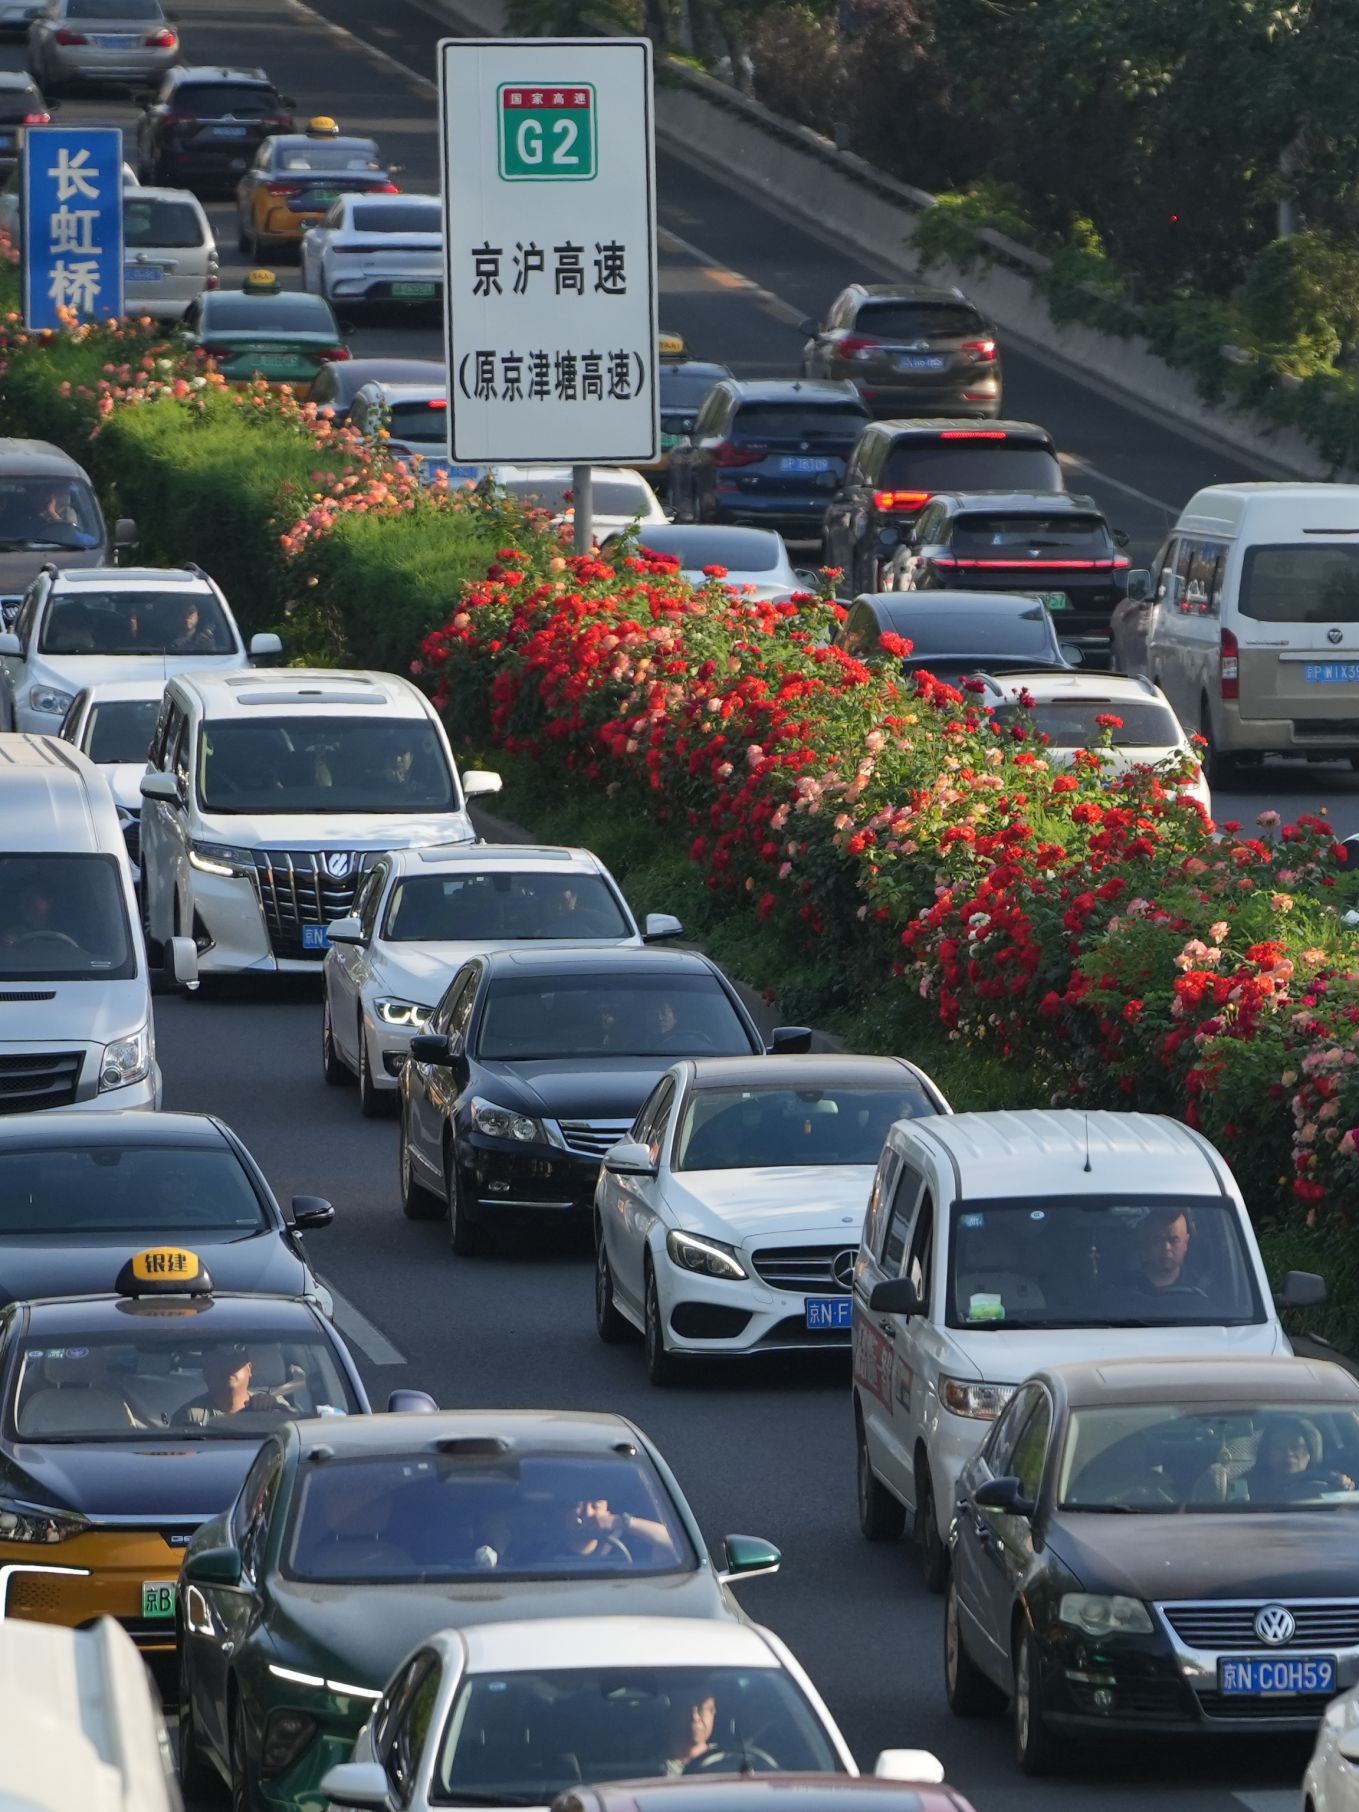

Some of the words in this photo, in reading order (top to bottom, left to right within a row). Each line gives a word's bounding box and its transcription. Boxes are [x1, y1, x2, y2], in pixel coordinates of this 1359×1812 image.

[510, 93, 586, 105] 国家高速
[517, 118, 579, 164] G2
[47, 148, 102, 314] 长虹桥
[471, 240, 627, 296] 京沪高速
[459, 349, 645, 401] (原京津塘高速)
[145, 1253, 188, 1273] 银建
